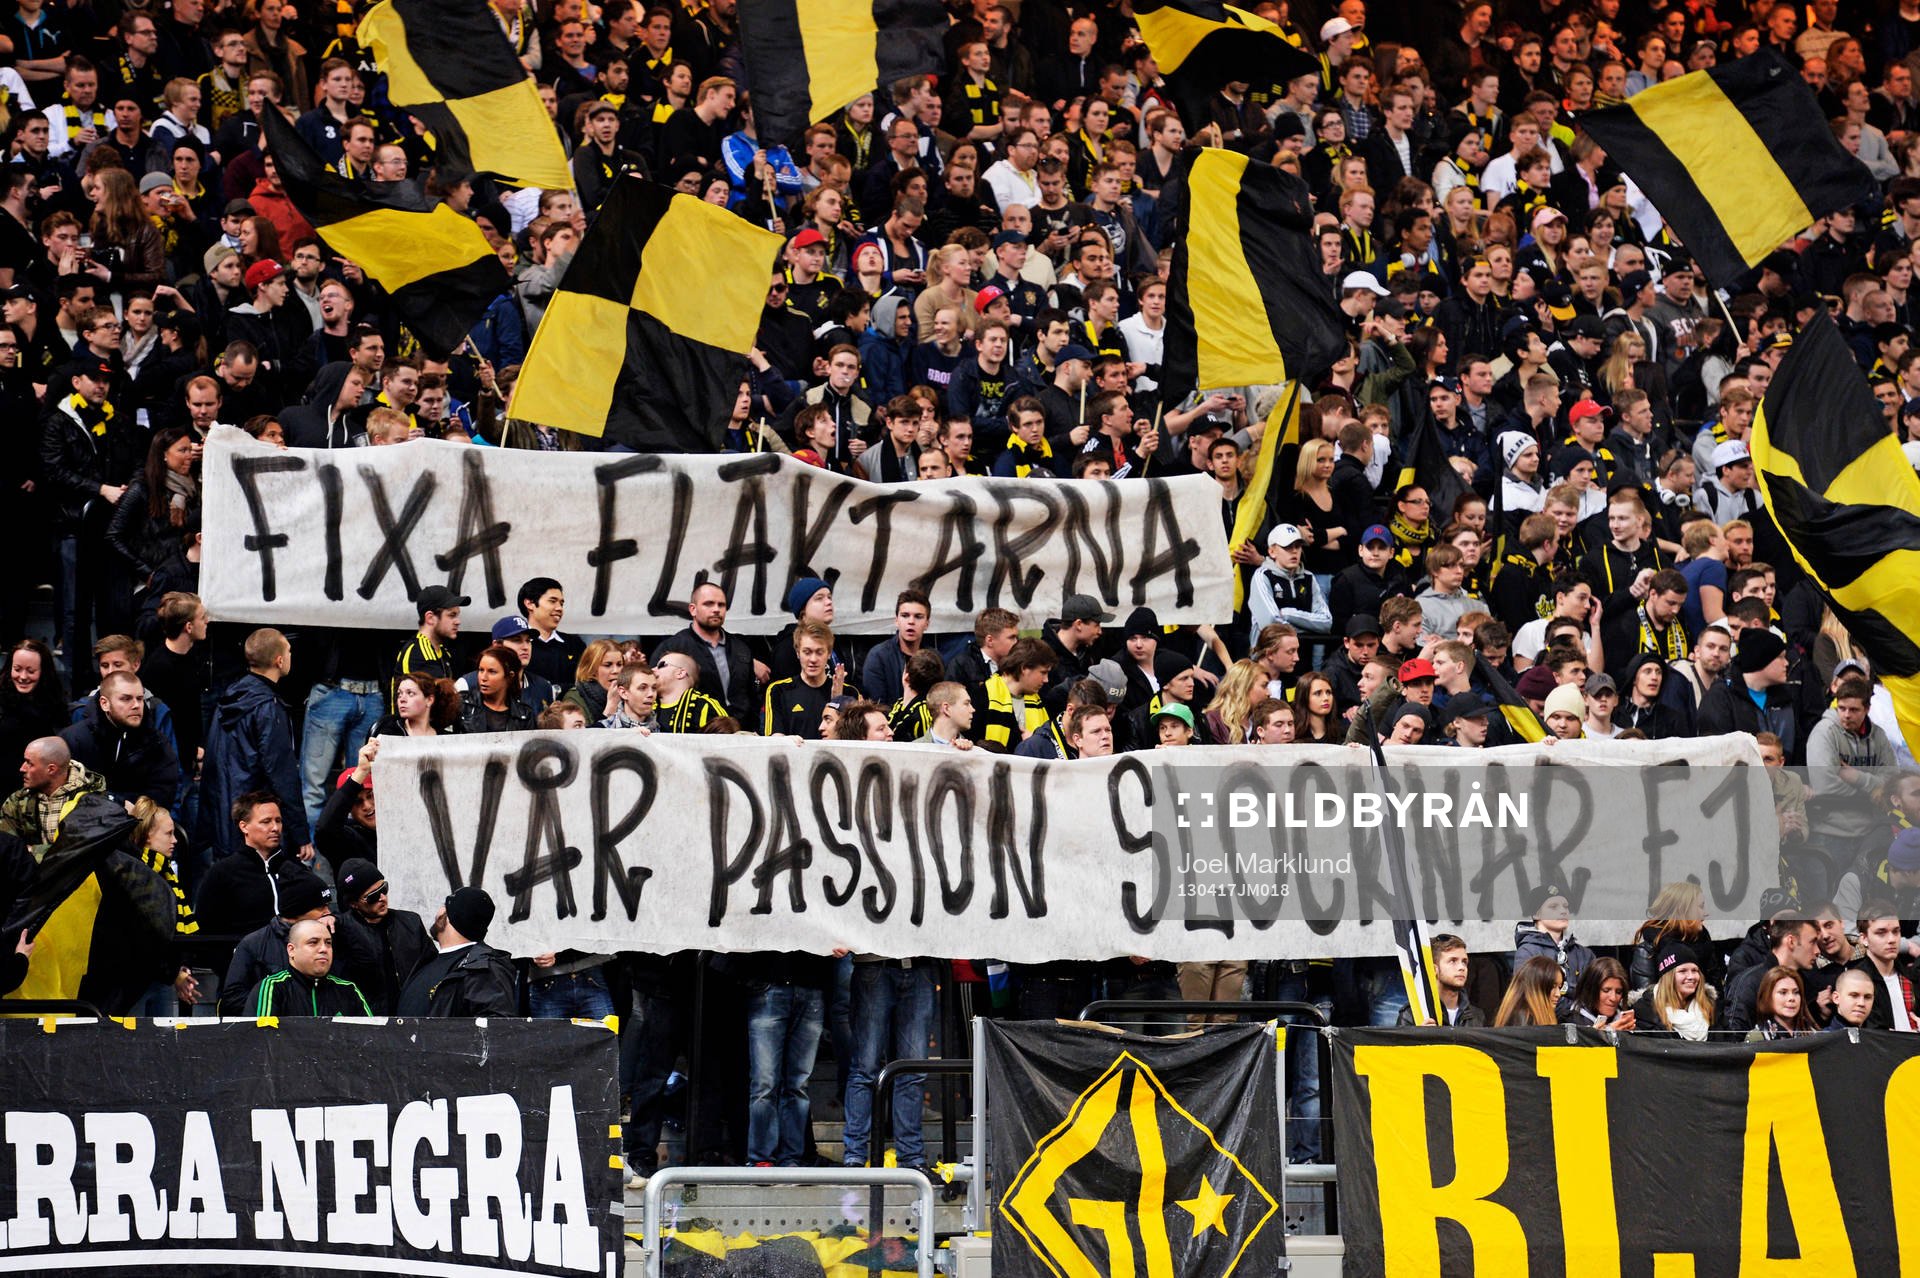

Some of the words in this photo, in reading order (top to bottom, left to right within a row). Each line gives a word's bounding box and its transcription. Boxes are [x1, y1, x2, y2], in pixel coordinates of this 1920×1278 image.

[231, 447, 511, 609] FIXA
[419, 737, 658, 923] VÅR
[702, 750, 1049, 928] PASSION
[0, 1111, 237, 1249] RRA
[251, 1085, 600, 1272] NEGRA
